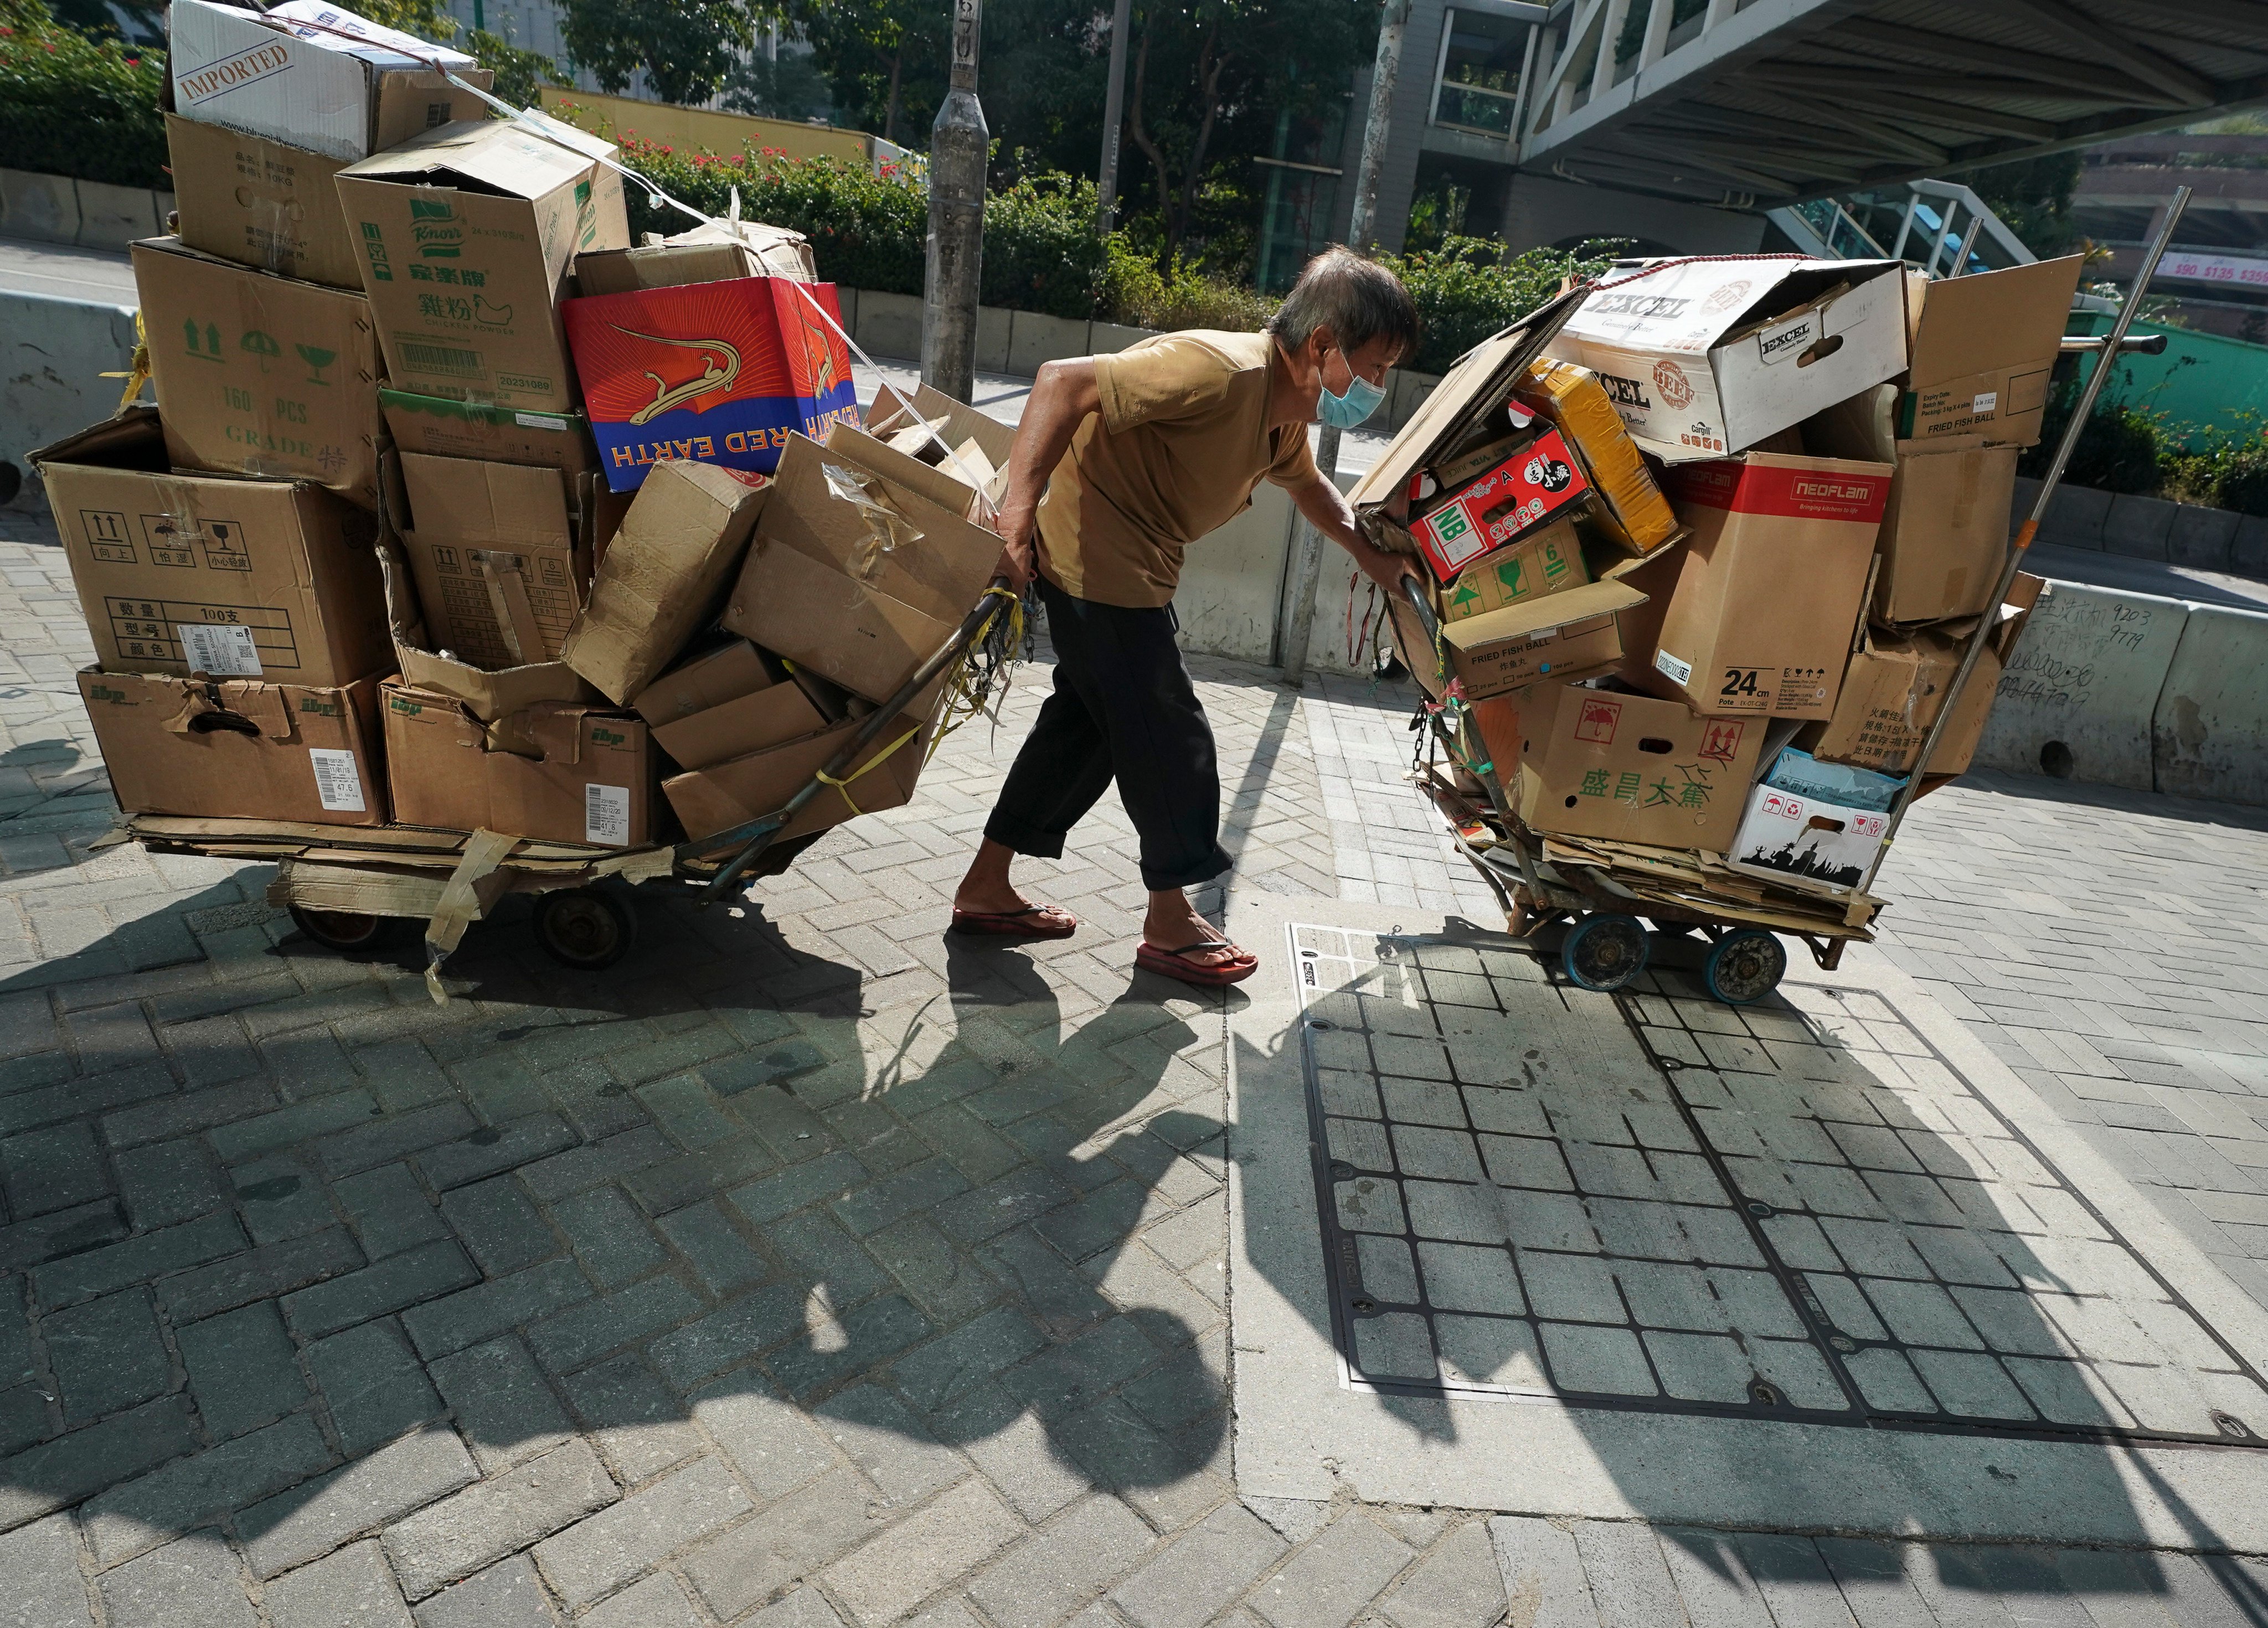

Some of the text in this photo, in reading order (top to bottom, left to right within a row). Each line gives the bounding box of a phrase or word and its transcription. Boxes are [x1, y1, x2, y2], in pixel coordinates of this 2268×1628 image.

[180, 44, 288, 100] IMPORTED
[411, 226, 463, 242] Knorr
[544, 211, 558, 261] Bonus Pack
[408, 264, 486, 287] 家樂牌
[2175, 264, 2198, 275] $90
[418, 293, 472, 321] 雞粉
[1583, 294, 1695, 319] EXCEL
[425, 319, 514, 336] CHICKEN POWDER
[1762, 322, 1810, 356] EXCEL
[499, 377, 550, 390] 20231089
[1652, 364, 1695, 405] BEEF
[223, 385, 307, 425] 160 PCS
[1923, 393, 1939, 401] Expiry
[1626, 412, 1647, 426] Better
[1921, 408, 1942, 416] Packing:
[1691, 424, 1712, 436] Cargill
[1927, 421, 1952, 434] FRIED
[1954, 417, 1973, 429] FISH
[1975, 413, 1996, 424] BALL
[225, 425, 314, 458] GRADE
[611, 426, 789, 467] RED EARTH
[317, 444, 348, 473] 特
[1528, 458, 1539, 470] 25
[1447, 464, 1467, 478] JUICE
[1501, 470, 1514, 485] A
[1800, 503, 1821, 513] Bringing
[1821, 503, 1843, 513] kitchens
[1850, 507, 1859, 515] life
[1433, 506, 1467, 542] NB
[99, 547, 130, 560] 向上
[158, 551, 188, 564] 怕湿
[1545, 544, 1557, 561] 6
[211, 555, 249, 568] 小心轻放
[119, 601, 156, 617] 数量
[200, 607, 240, 624] 100支
[2114, 603, 2152, 627] 9203
[2110, 625, 2145, 652] 9779
[130, 642, 165, 657] 颜色
[1471, 638, 1551, 665] FRIED FISH BALL
[1499, 657, 1527, 672] 炸鱼丸
[1720, 669, 1770, 698] 24 cm
[91, 685, 125, 702] ibp
[301, 698, 334, 715] ibp
[390, 697, 422, 716] ibp
[591, 728, 625, 745] ibp
[337, 784, 353, 792] 47.6
[1578, 768, 1705, 808] 盛昌大蕉
